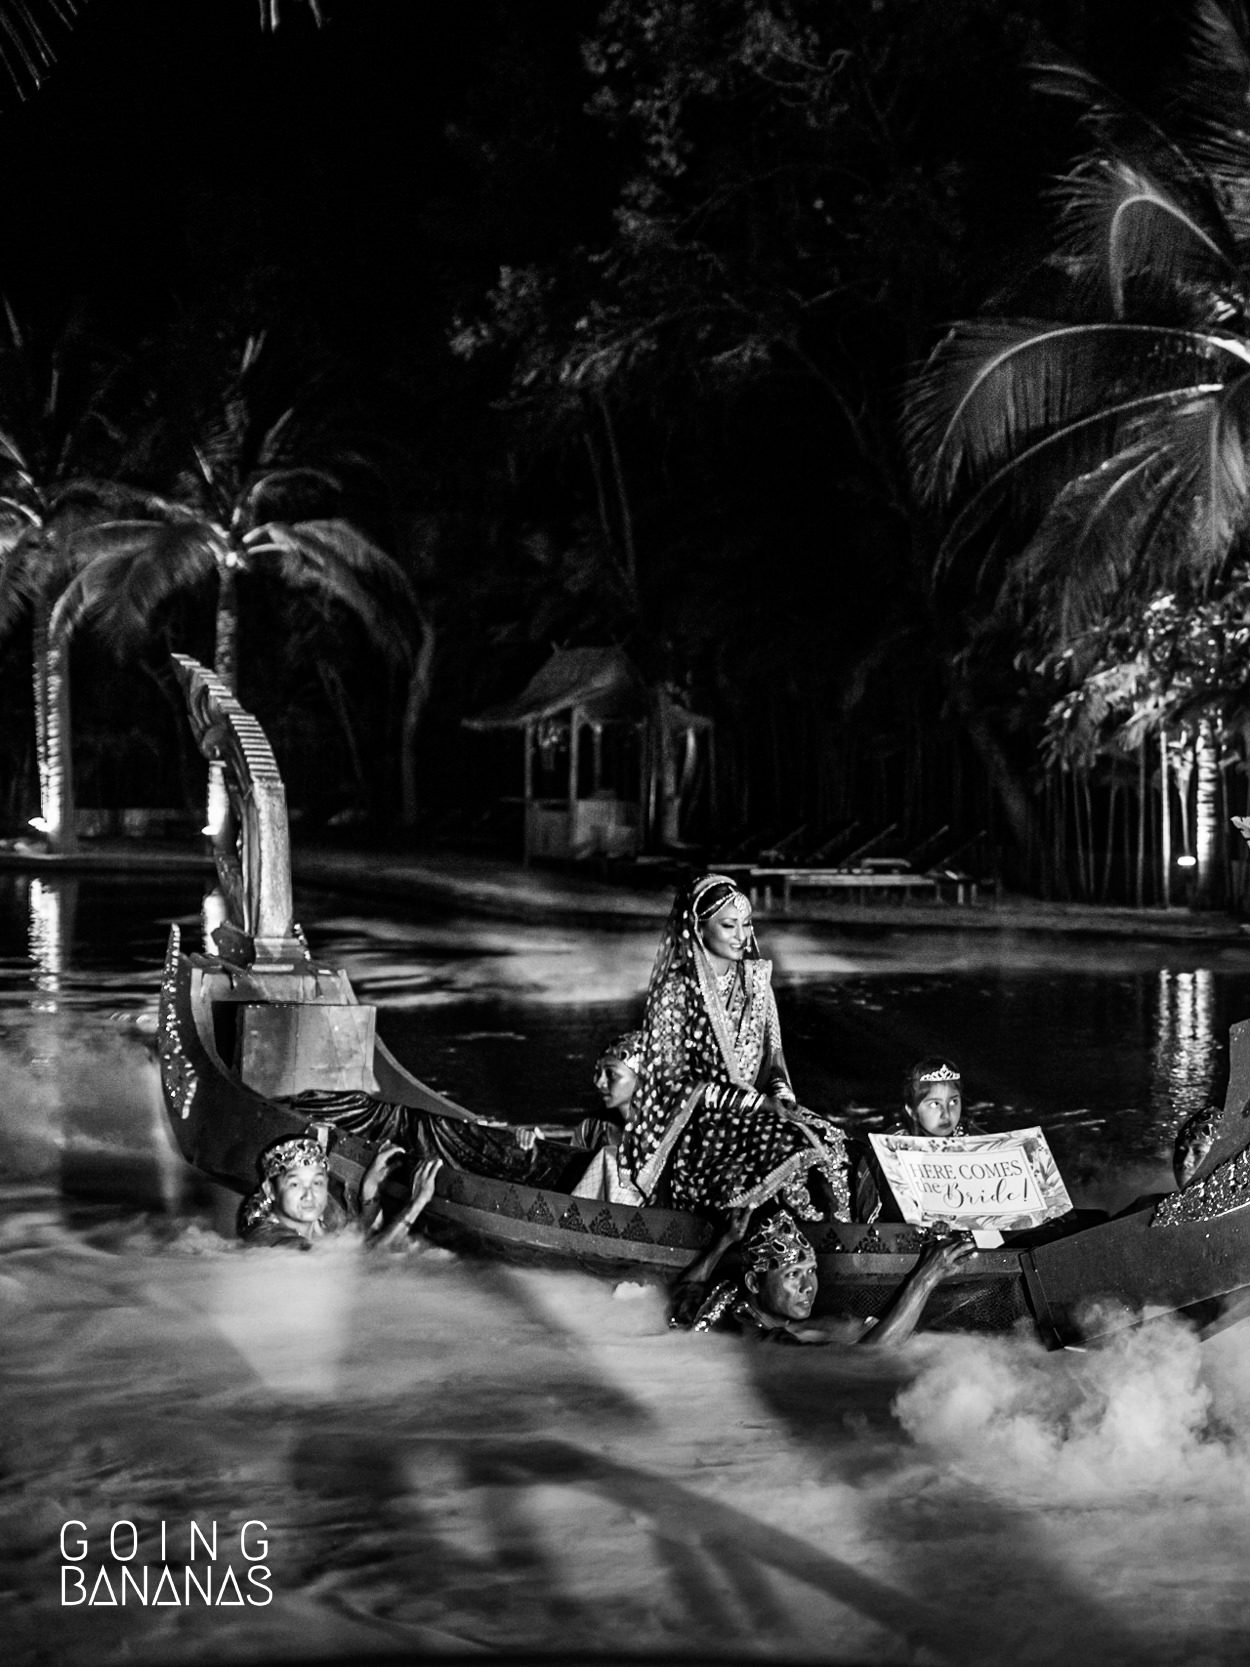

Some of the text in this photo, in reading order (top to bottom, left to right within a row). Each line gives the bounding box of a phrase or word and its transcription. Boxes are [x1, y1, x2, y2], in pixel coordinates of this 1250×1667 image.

[910, 1160, 1023, 1180] HERE COMES
[917, 1178, 1028, 1208] the Bride!
